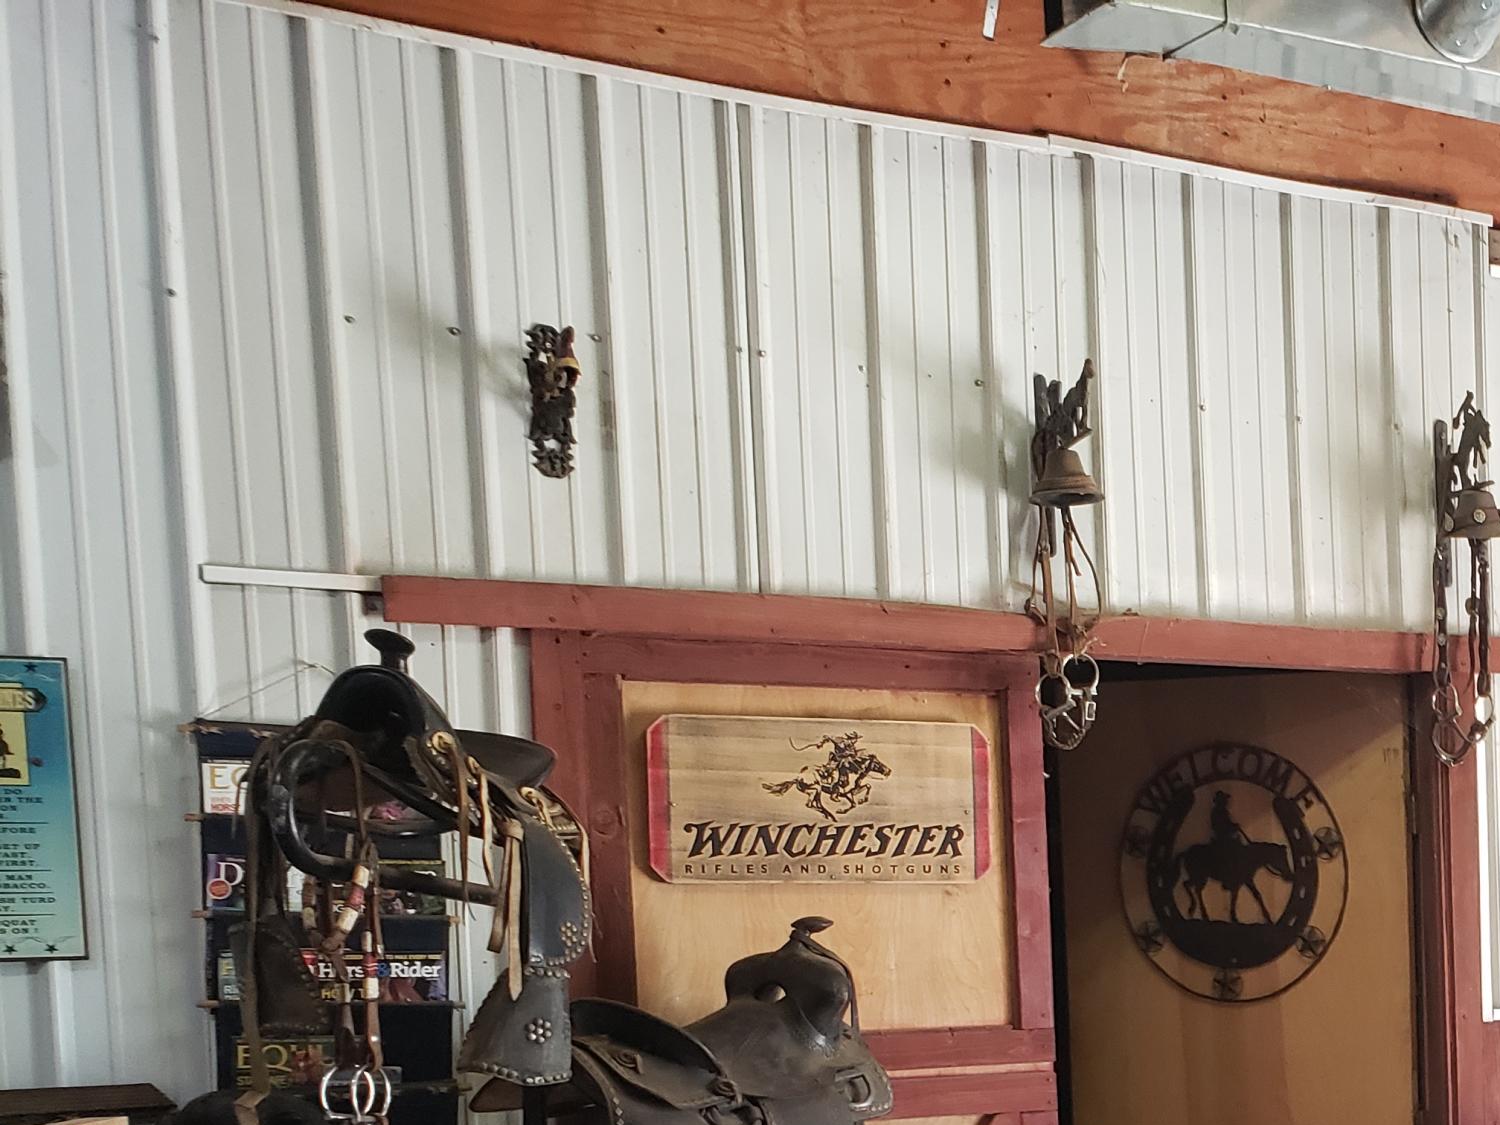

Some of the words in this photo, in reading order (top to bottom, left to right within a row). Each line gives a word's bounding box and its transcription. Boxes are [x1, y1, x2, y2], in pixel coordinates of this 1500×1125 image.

[1134, 747, 1323, 817] WELCOME
[684, 820, 965, 858] WINCHESTER
[685, 864, 769, 875] RIFLES
[782, 864, 827, 875] AND
[843, 864, 961, 875] SHOTGUNS
